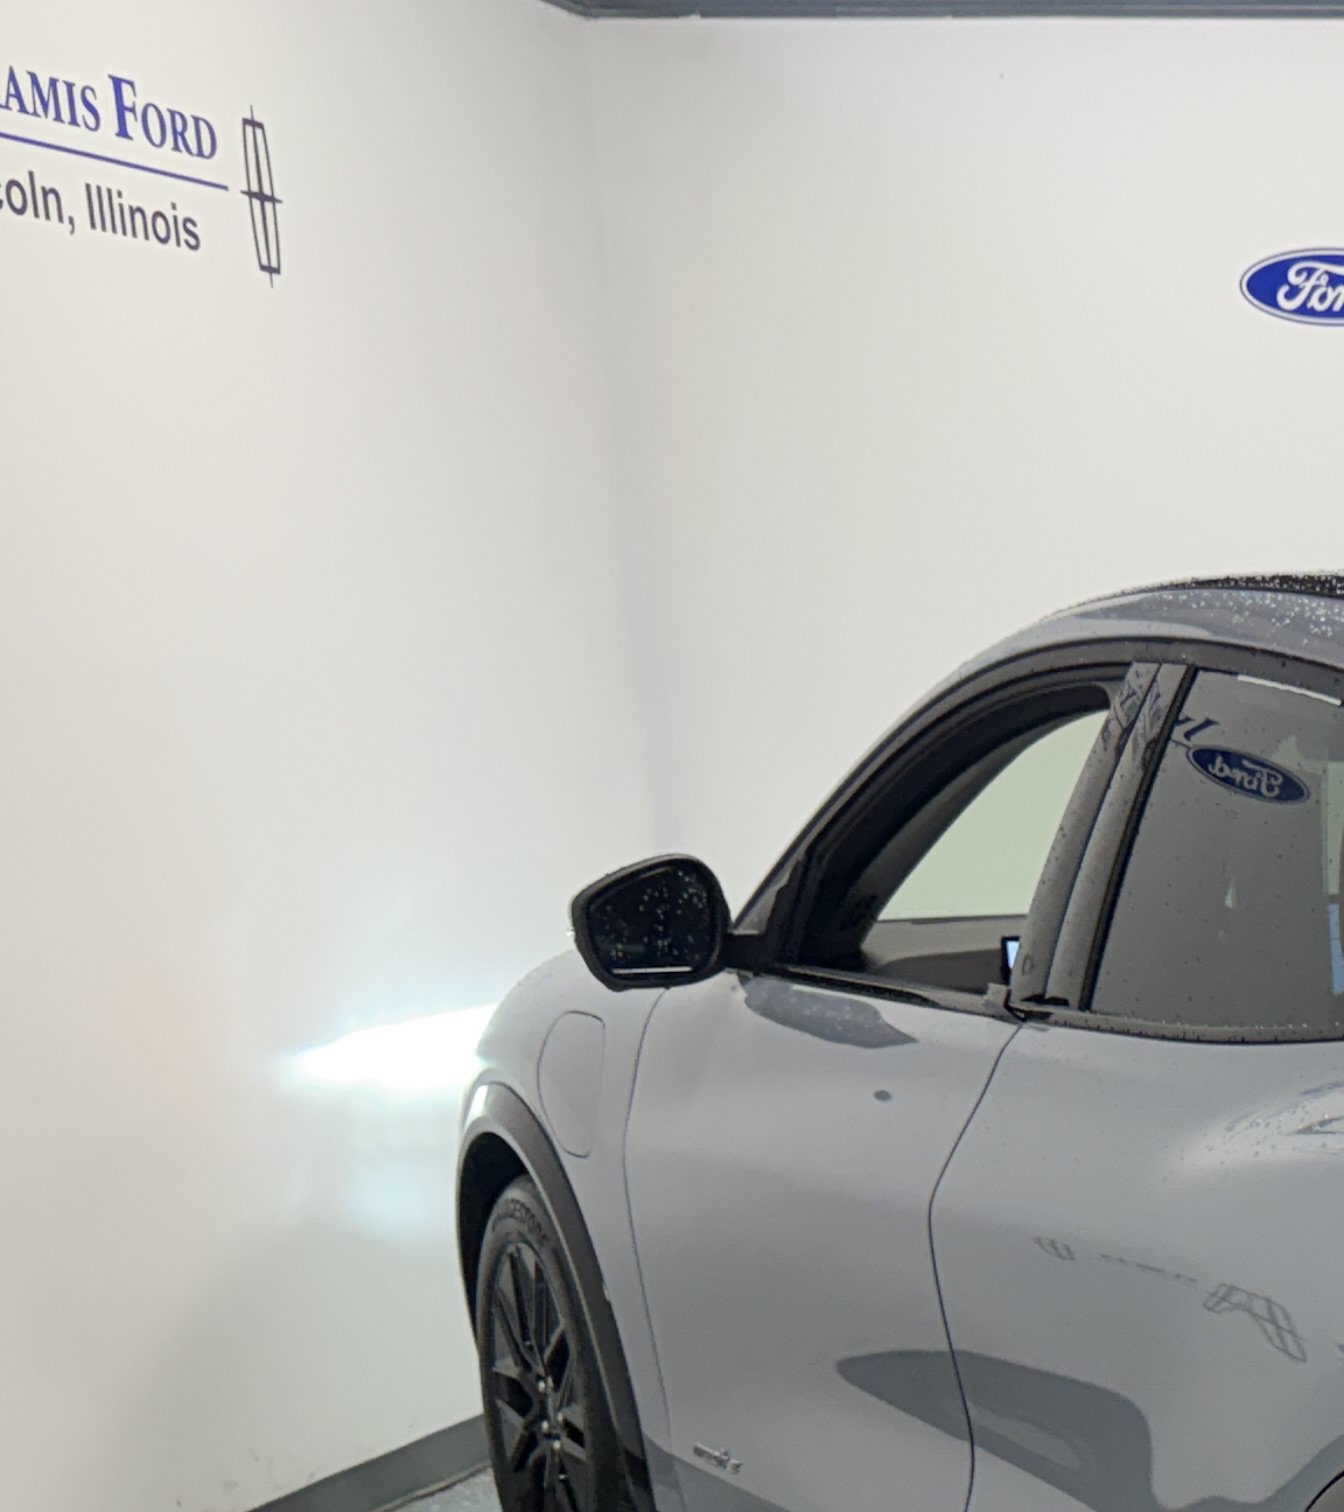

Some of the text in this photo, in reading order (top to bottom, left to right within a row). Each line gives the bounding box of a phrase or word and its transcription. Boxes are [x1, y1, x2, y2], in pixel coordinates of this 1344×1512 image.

[0, 65, 101, 132] AMIS
[0, 170, 200, 251] oln, Illinois
